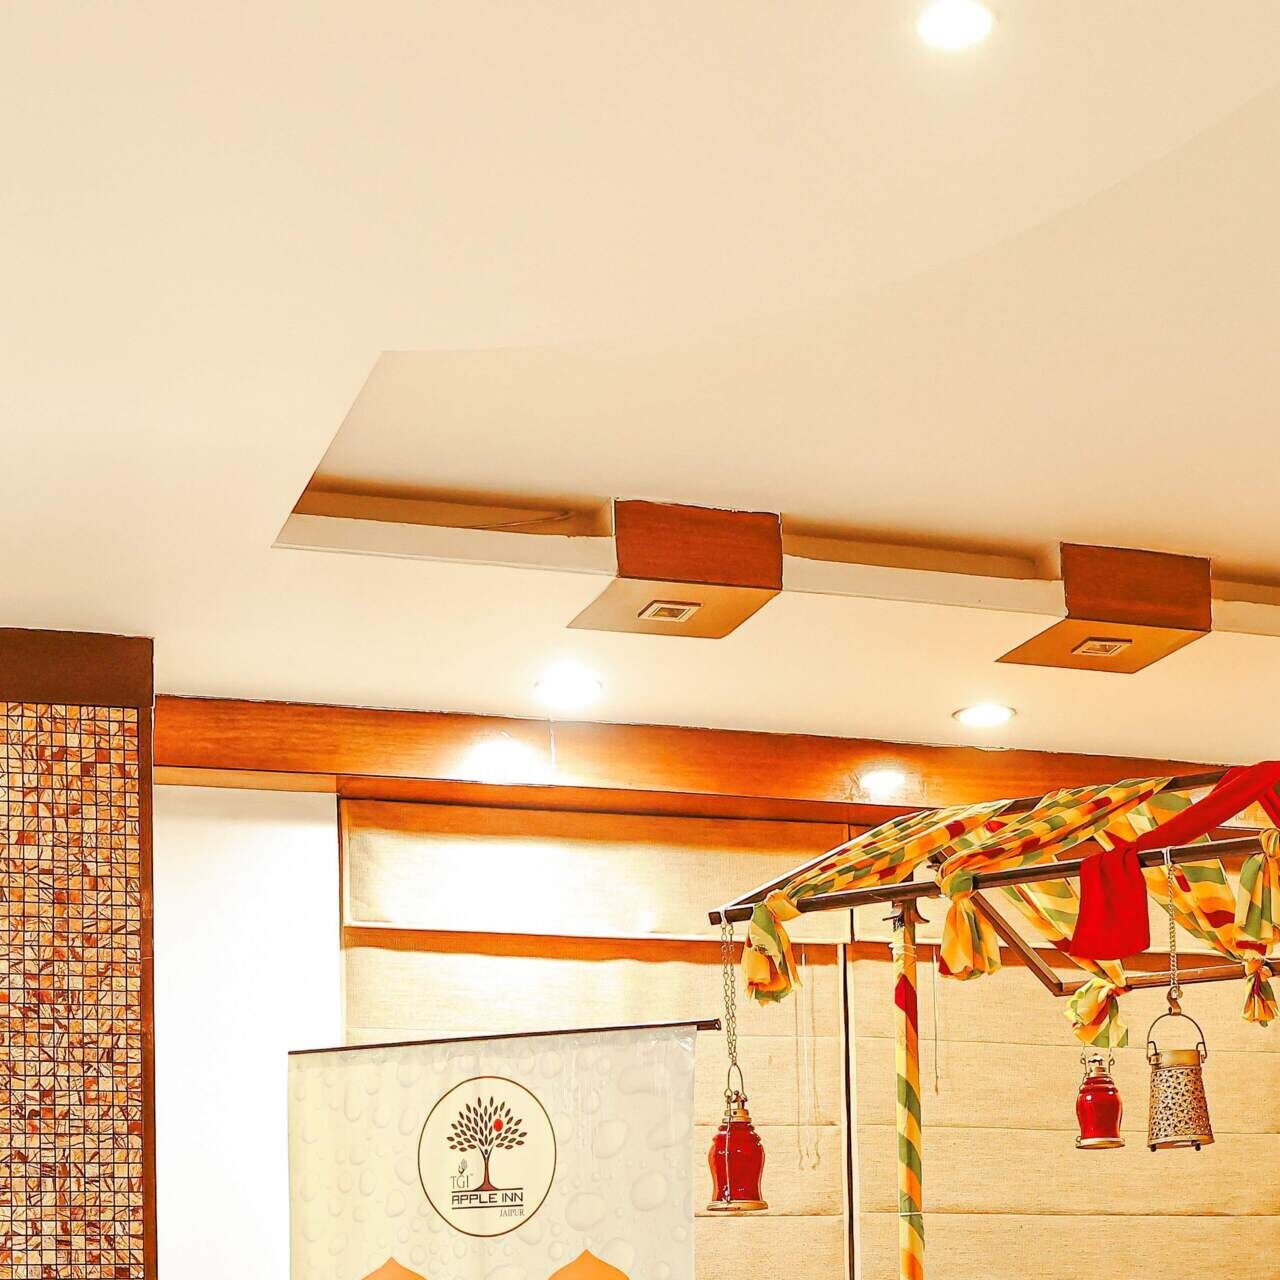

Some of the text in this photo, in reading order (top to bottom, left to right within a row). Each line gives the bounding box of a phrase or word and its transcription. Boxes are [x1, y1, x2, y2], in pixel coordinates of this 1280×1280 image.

[450, 1174, 469, 1189] TGI
[451, 1192, 524, 1205] APPLE INN
